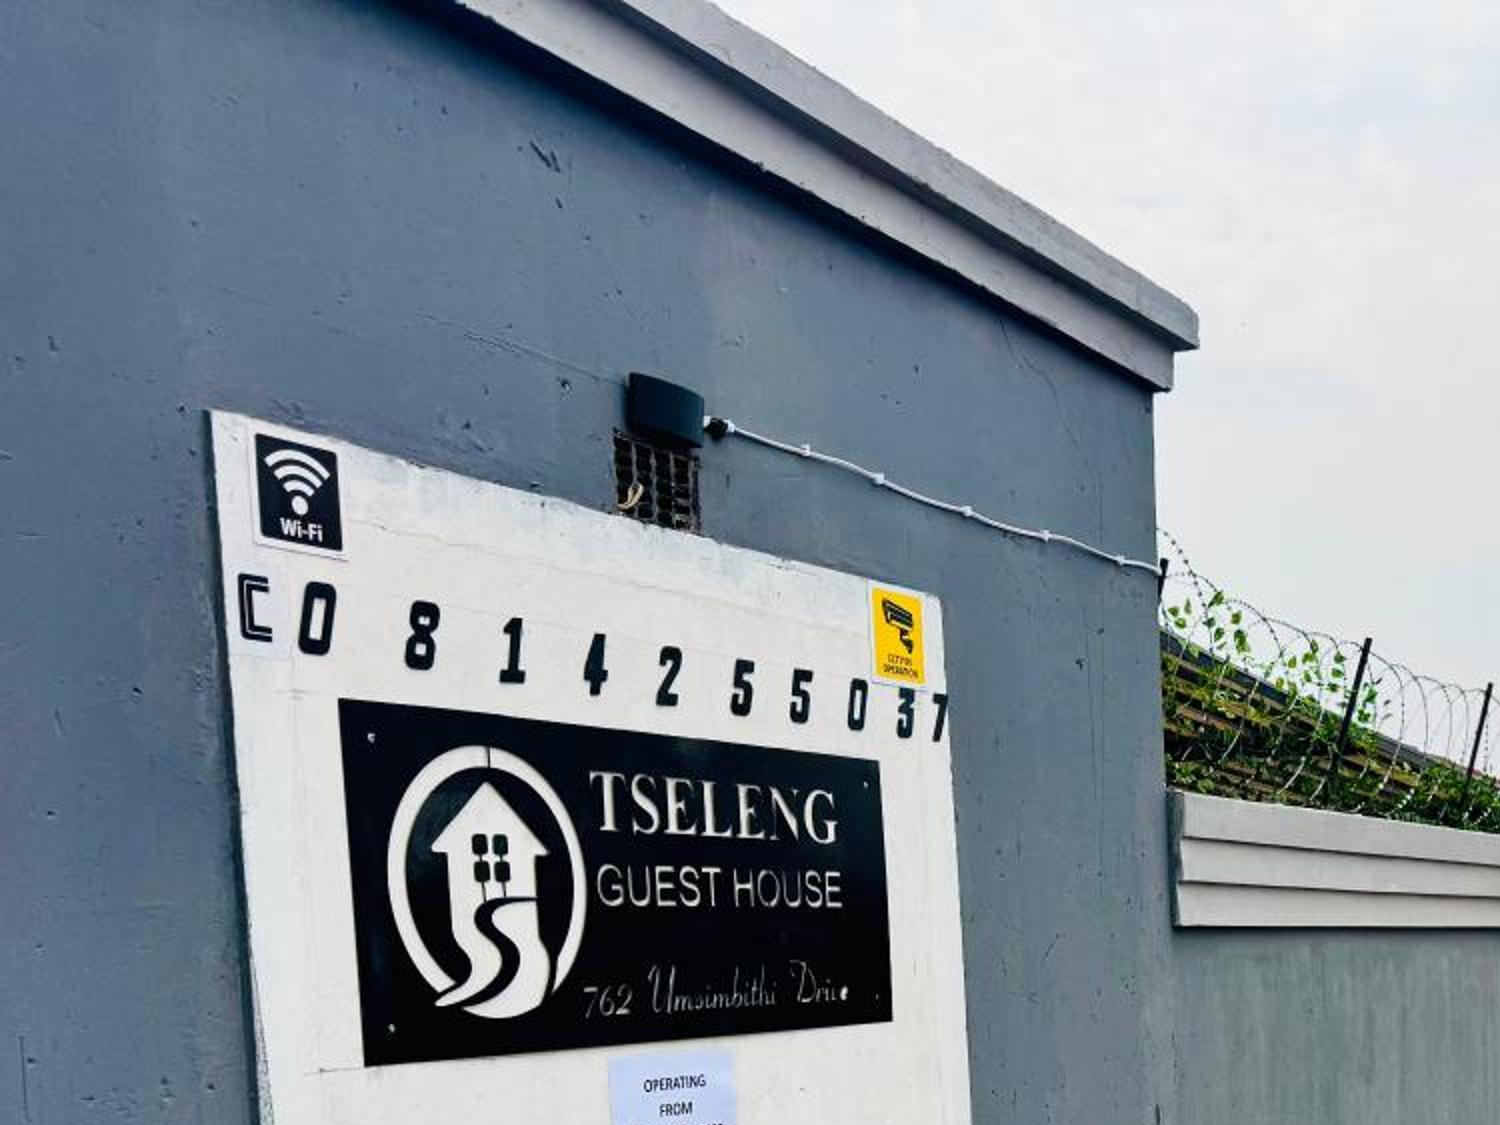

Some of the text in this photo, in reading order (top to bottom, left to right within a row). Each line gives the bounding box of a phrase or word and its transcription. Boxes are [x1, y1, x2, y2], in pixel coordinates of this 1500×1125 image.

[279, 517, 323, 543] Wi-Fi
[589, 771, 839, 845] TSELENG
[597, 863, 843, 909] GUEST HOUSE
[583, 983, 633, 1018] 762
[643, 1073, 707, 1093] OPERATING
[659, 1101, 693, 1117] FROM
